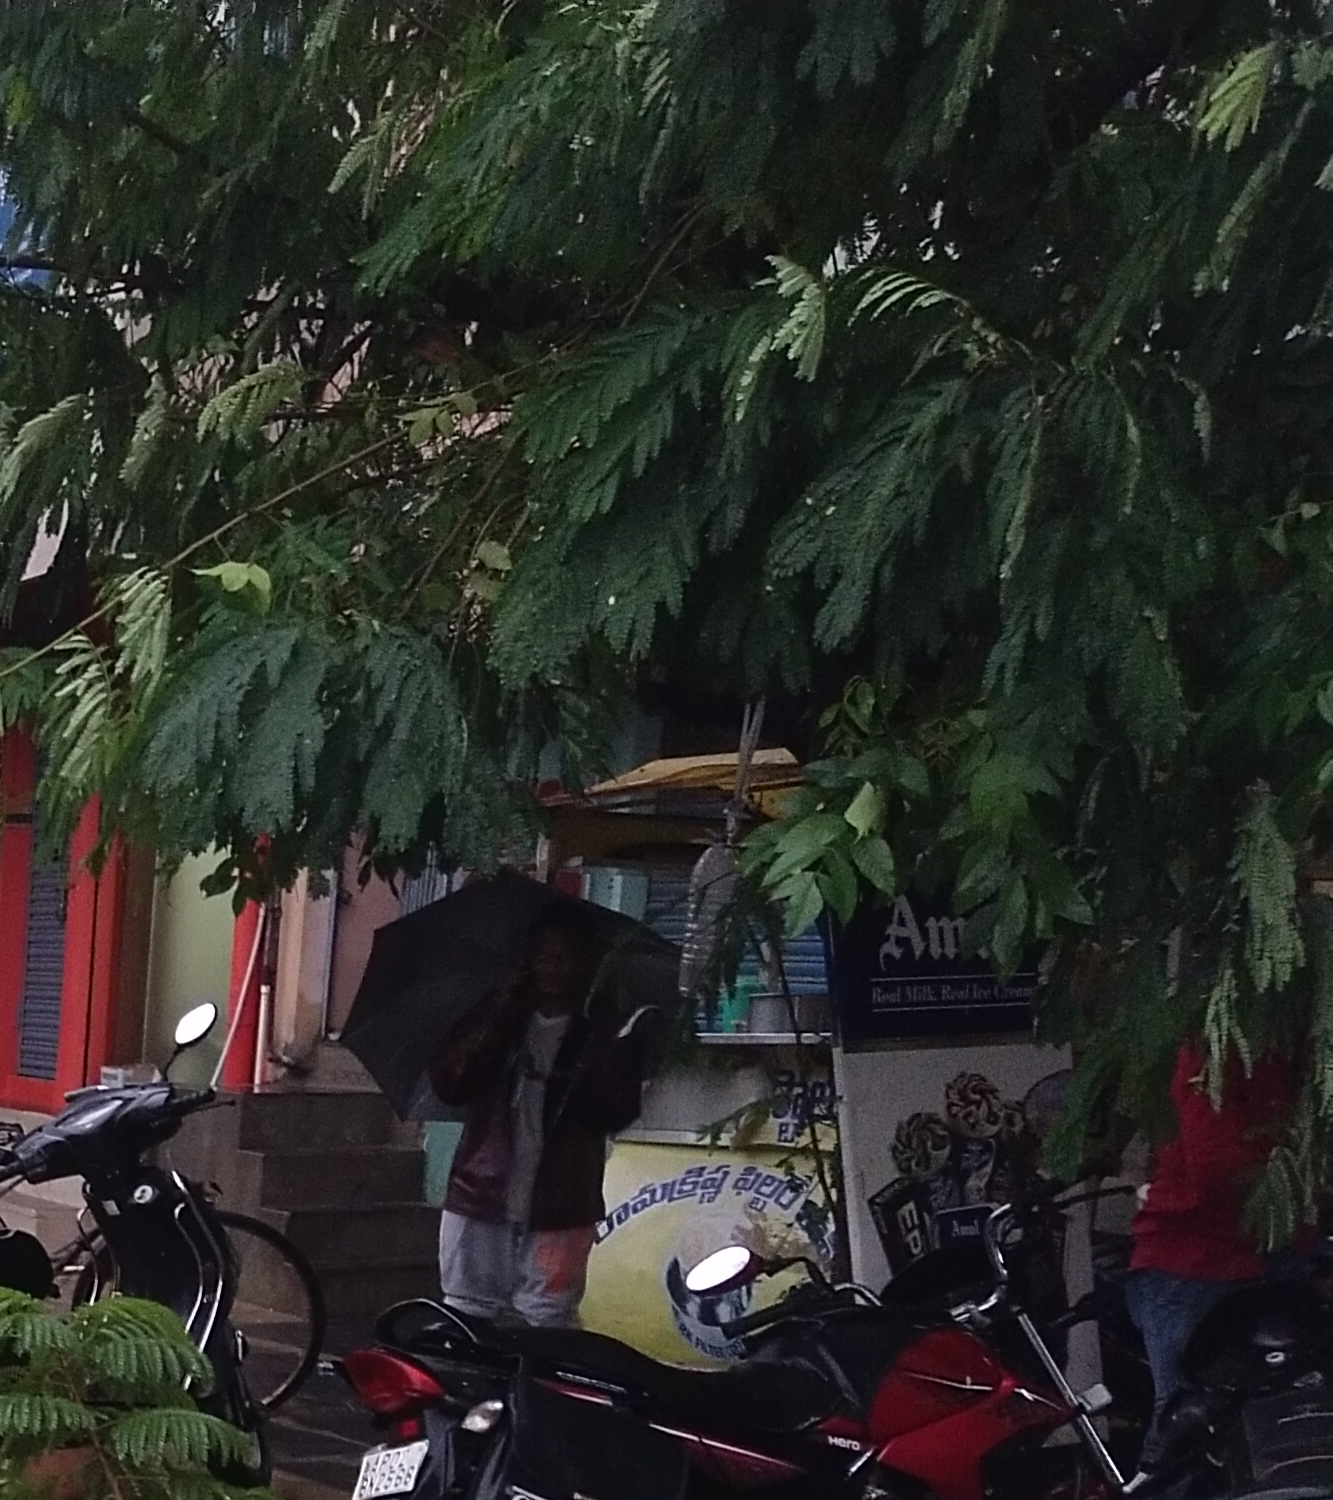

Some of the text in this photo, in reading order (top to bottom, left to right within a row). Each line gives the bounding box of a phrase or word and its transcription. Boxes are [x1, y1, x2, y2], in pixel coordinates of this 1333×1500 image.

[879, 894, 990, 971] Am
[871, 986, 900, 1004] Real
[941, 983, 970, 1001] Real
[973, 982, 991, 1000] Ice
[951, 1219, 980, 1237] Amul
[827, 1435, 861, 1451] Hero
